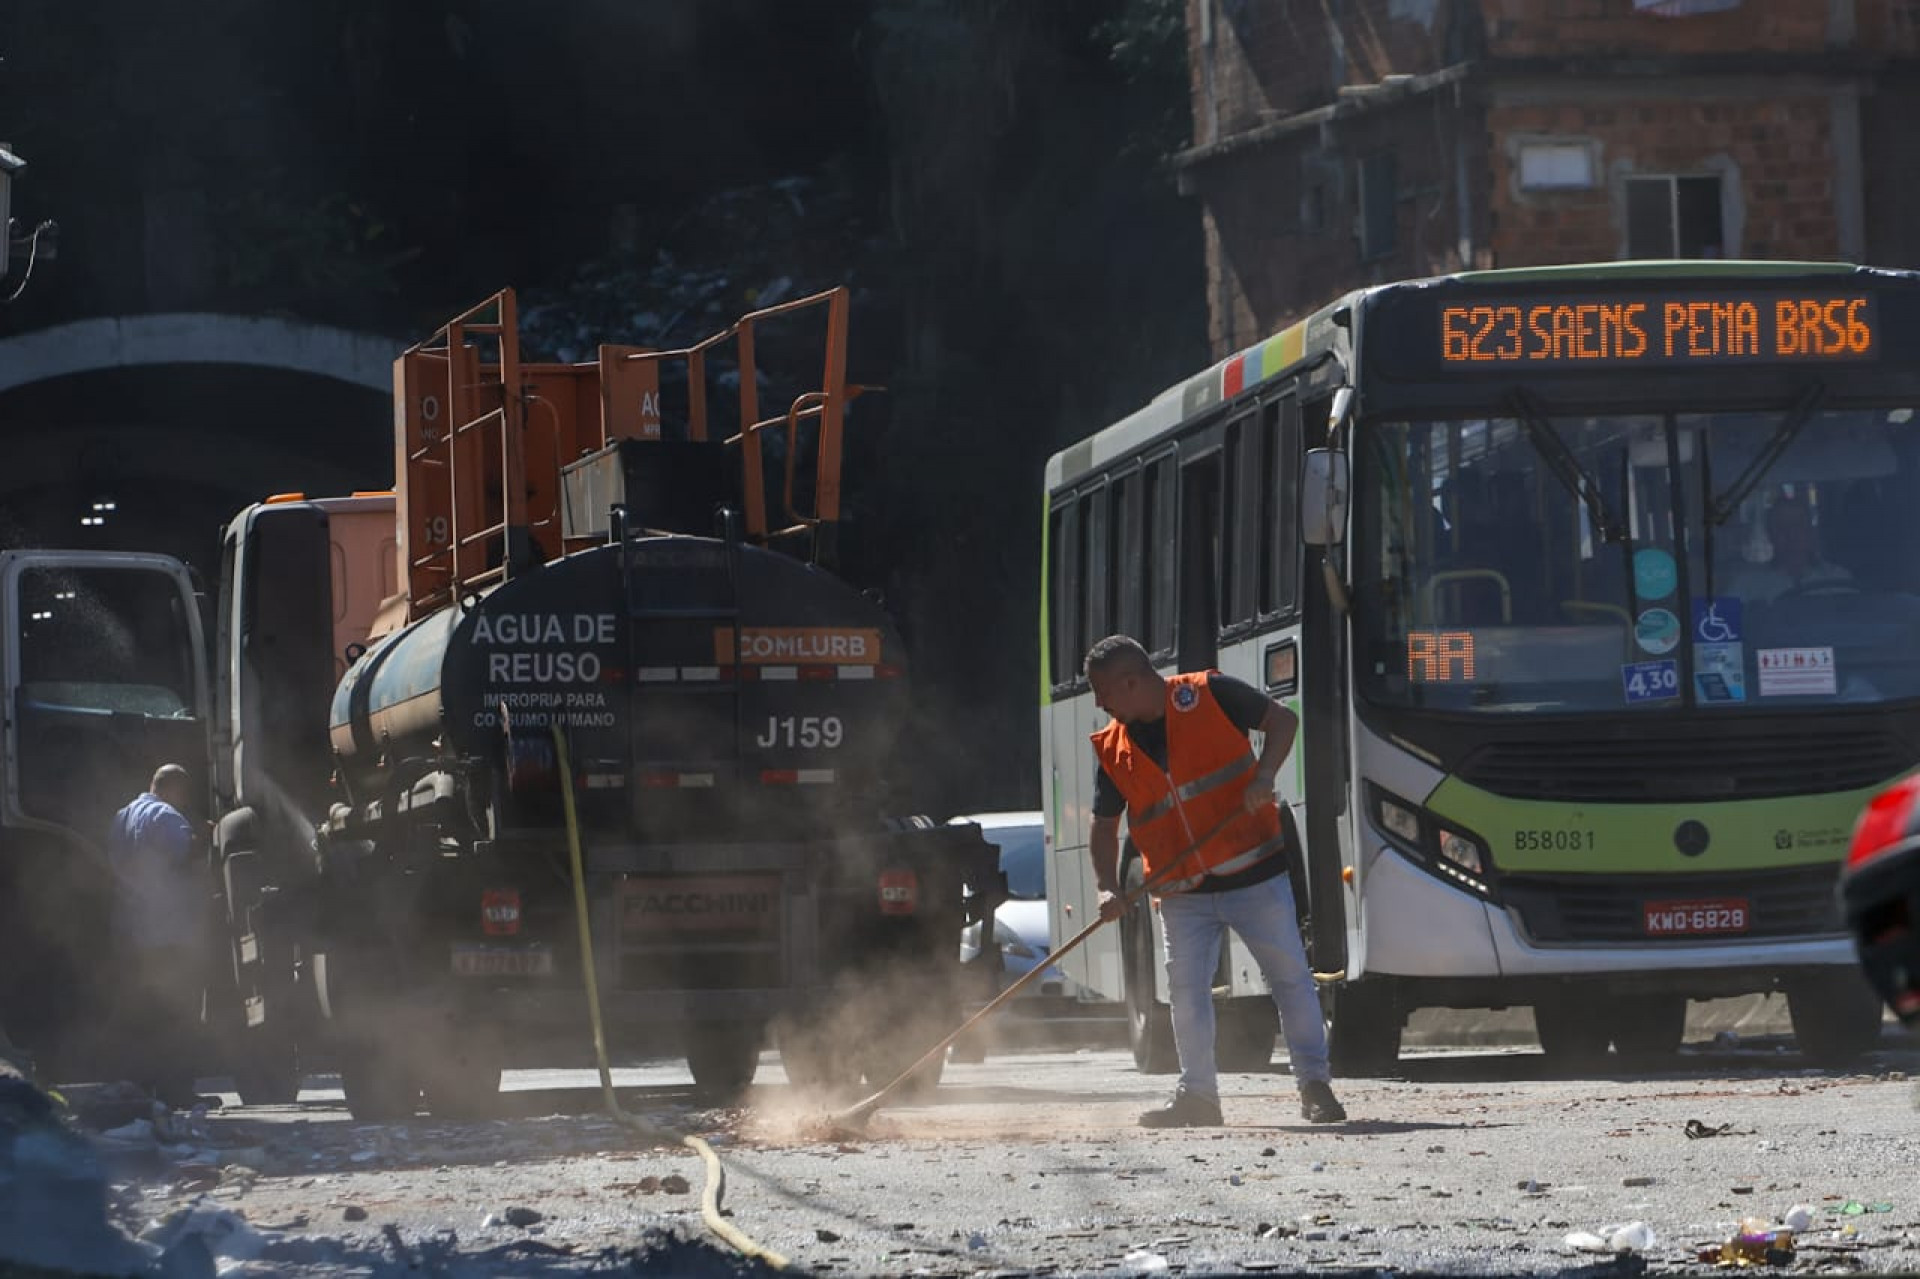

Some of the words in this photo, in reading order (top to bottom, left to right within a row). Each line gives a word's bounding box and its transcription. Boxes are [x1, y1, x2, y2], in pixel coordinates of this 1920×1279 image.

[1443, 306, 1522, 360] 623
[1529, 303, 1647, 359] SAENS
[1776, 299, 1870, 355] BRS6
[574, 613, 616, 643] DE
[740, 634, 866, 657] COMLURB
[489, 652, 601, 683] REUSO
[566, 692, 606, 707] PARA
[473, 711, 549, 727] COSUMO
[757, 716, 844, 749] J159
[1514, 829, 1595, 851] B58081
